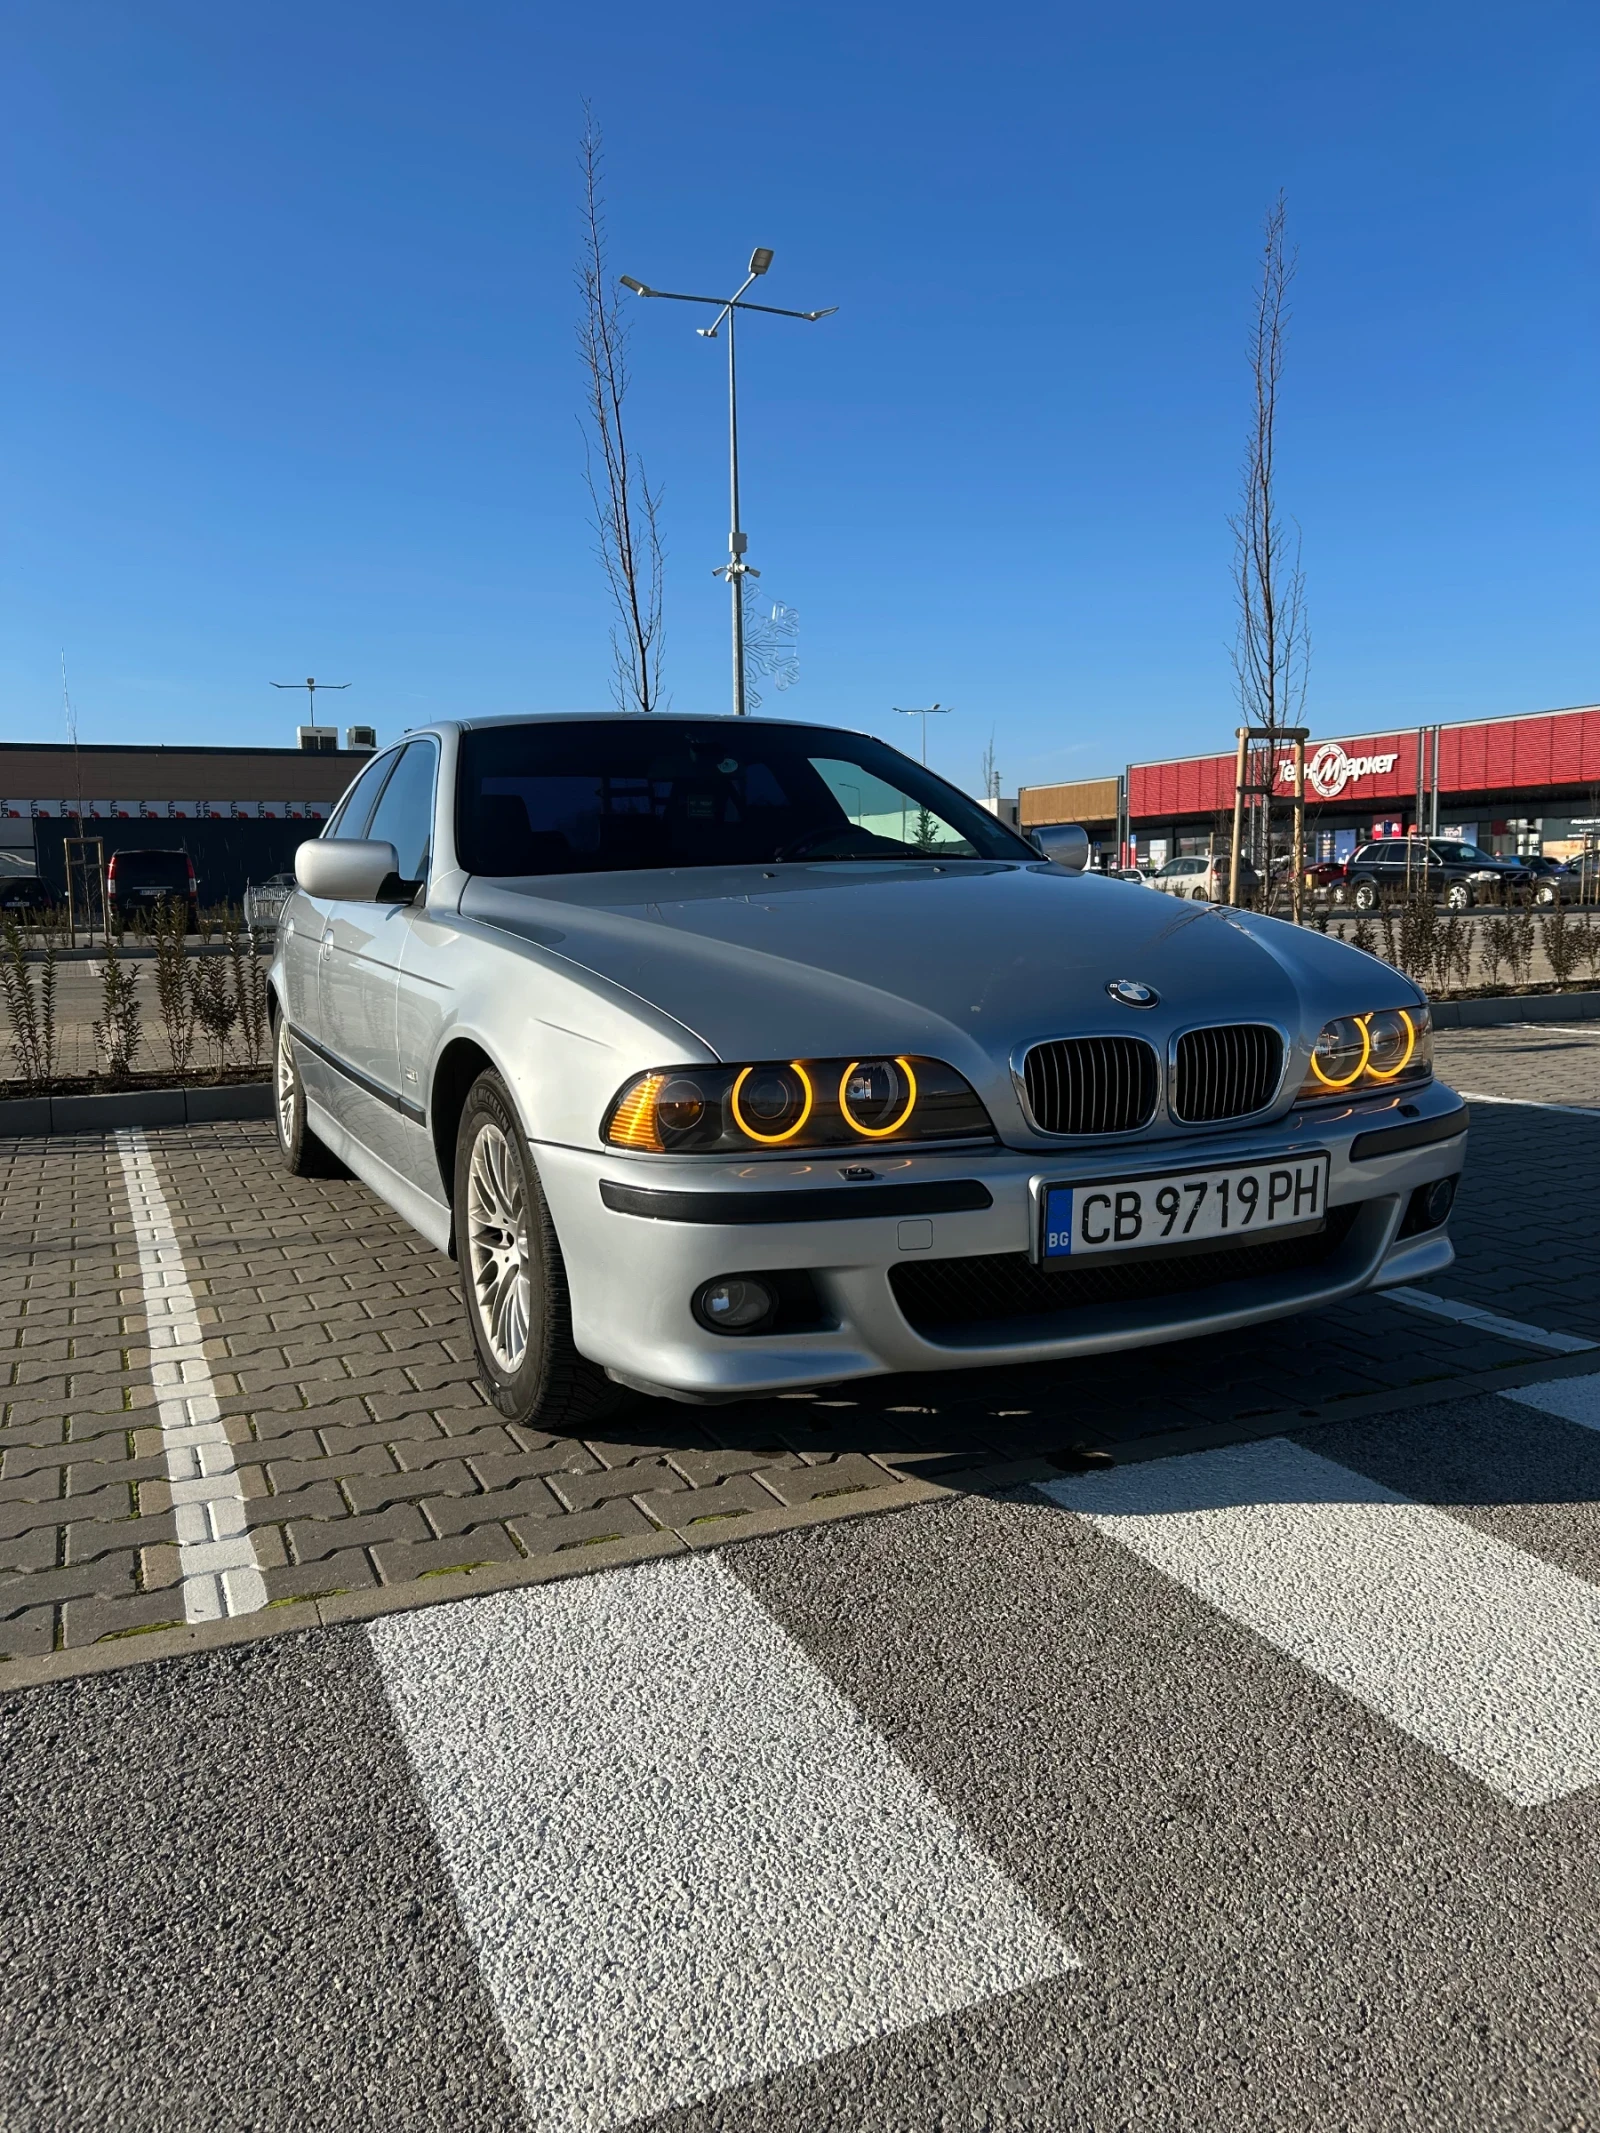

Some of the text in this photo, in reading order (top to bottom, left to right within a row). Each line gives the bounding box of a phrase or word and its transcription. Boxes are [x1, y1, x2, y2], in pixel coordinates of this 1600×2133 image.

[1081, 1165, 1319, 1245] CB 9719 PH
[1048, 1232, 1069, 1248] BG
